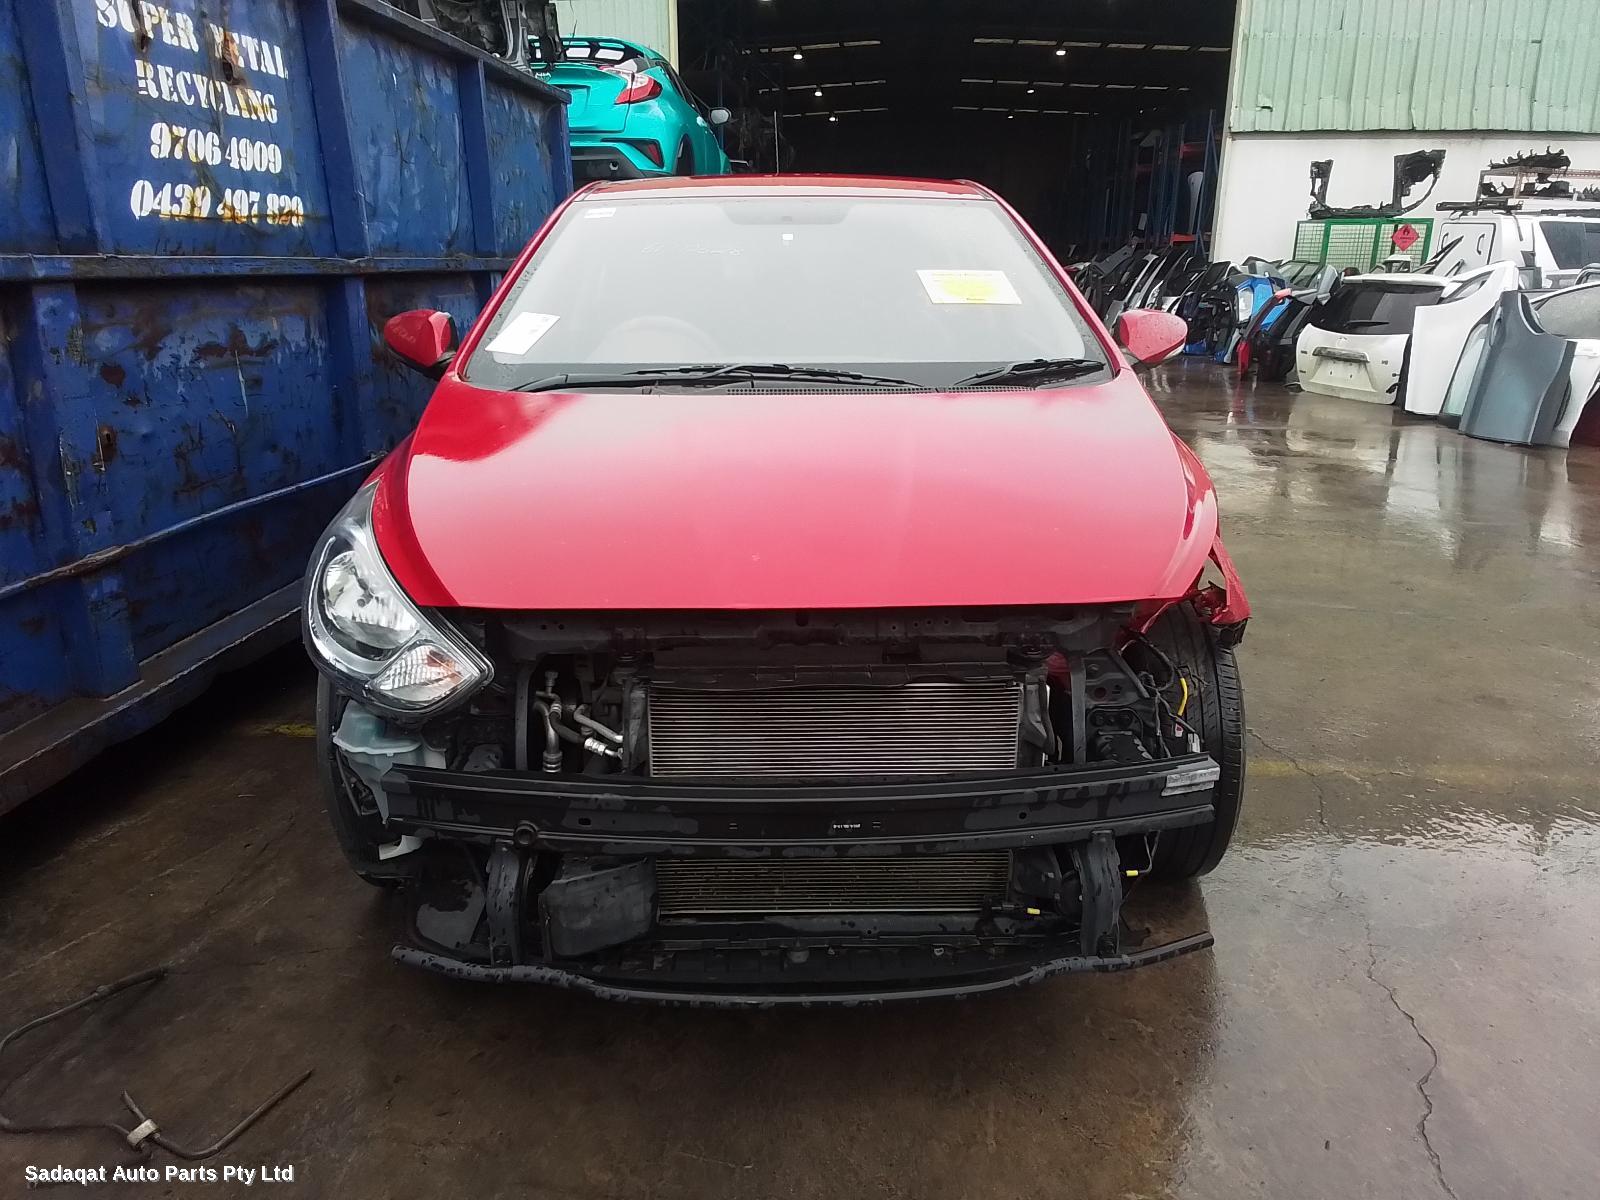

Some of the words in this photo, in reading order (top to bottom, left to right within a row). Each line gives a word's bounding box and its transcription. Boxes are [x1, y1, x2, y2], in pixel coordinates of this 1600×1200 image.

[134, 59, 278, 124] RECYCLING
[150, 122, 222, 166] 9706
[224, 136, 283, 174] 4909
[131, 179, 212, 220] 0439
[216, 188, 261, 225] 497
